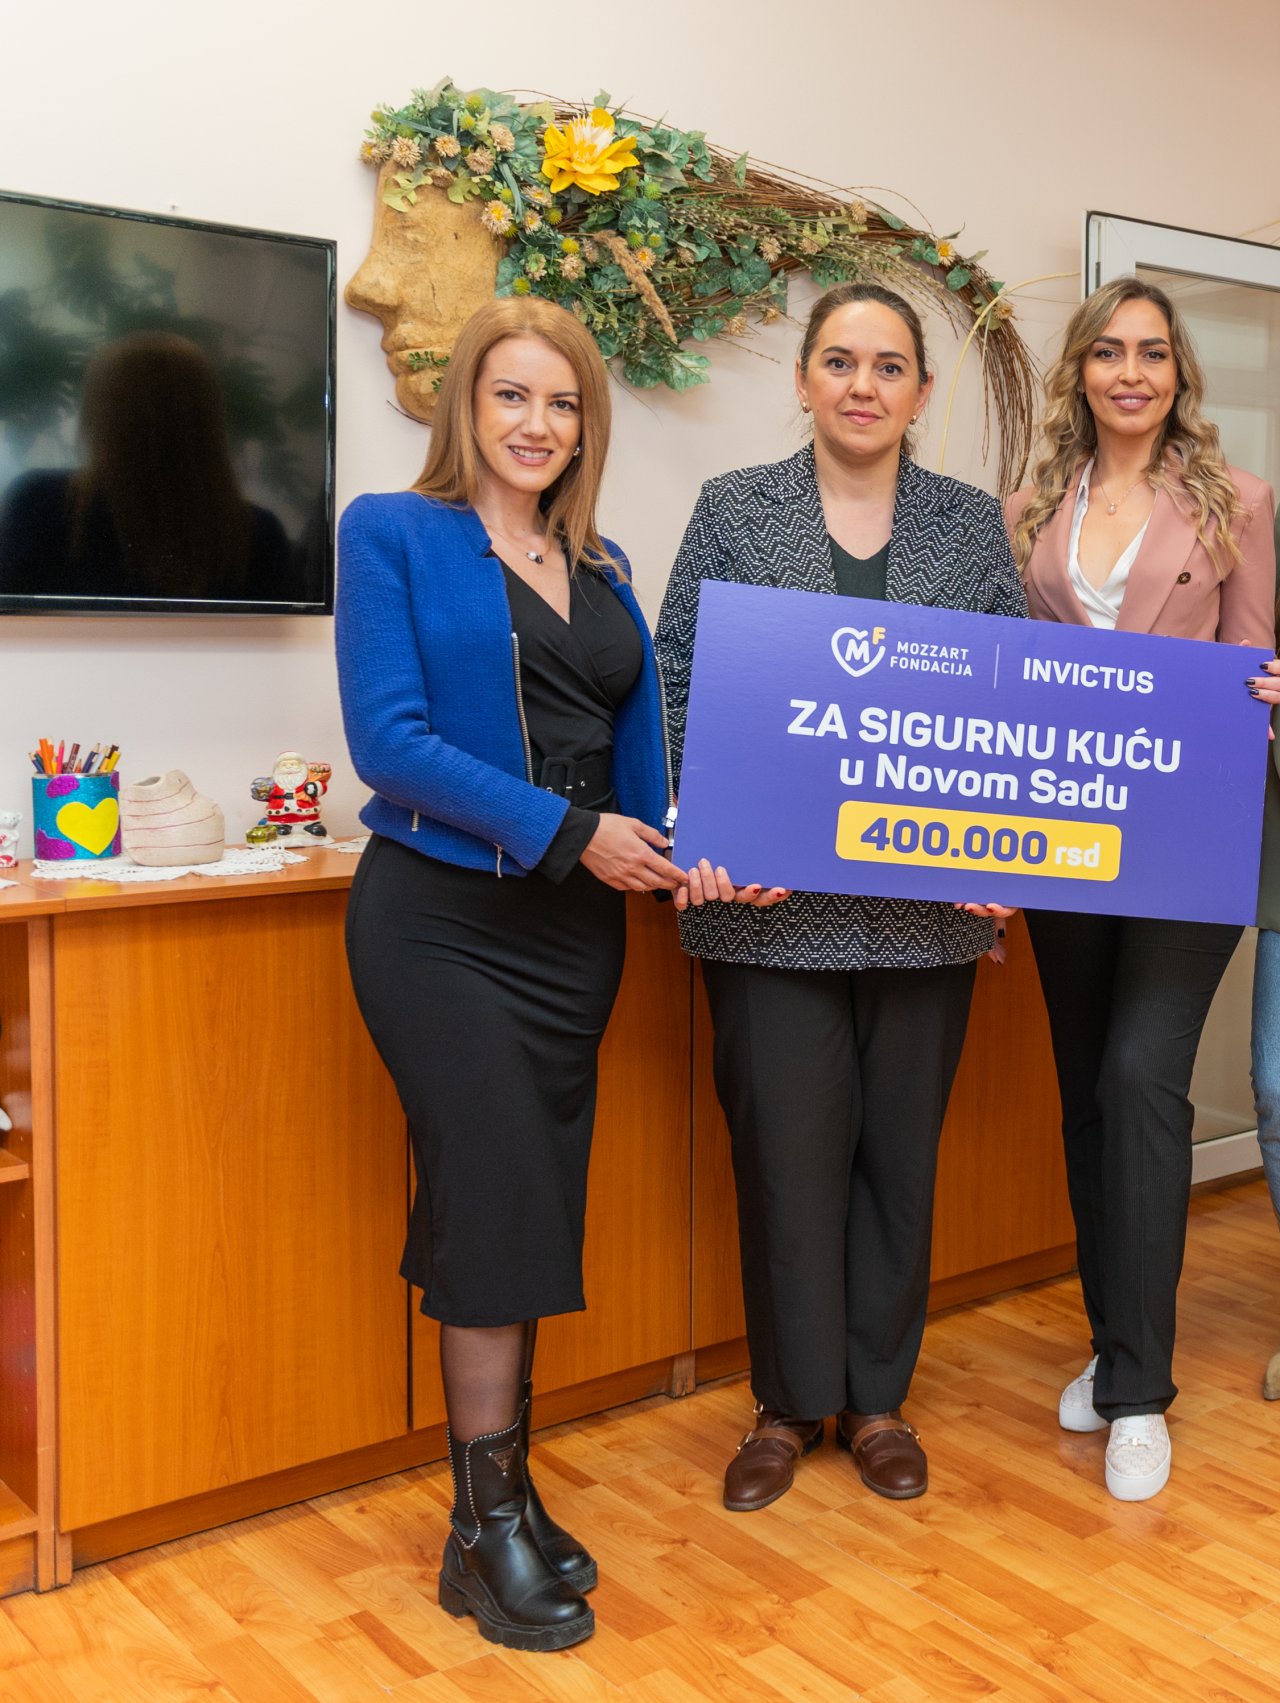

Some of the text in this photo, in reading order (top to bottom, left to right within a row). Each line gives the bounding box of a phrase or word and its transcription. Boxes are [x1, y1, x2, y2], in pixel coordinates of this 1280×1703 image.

[889, 655, 973, 677] FONDACIJA
[896, 640, 969, 661] MOZZART
[1023, 657, 1155, 695] INVICTUS
[786, 698, 1182, 773] ZA SIGURNU KUĆU
[839, 752, 1129, 811] u Novom Sadu
[860, 817, 1101, 868] 400.000 rsd
